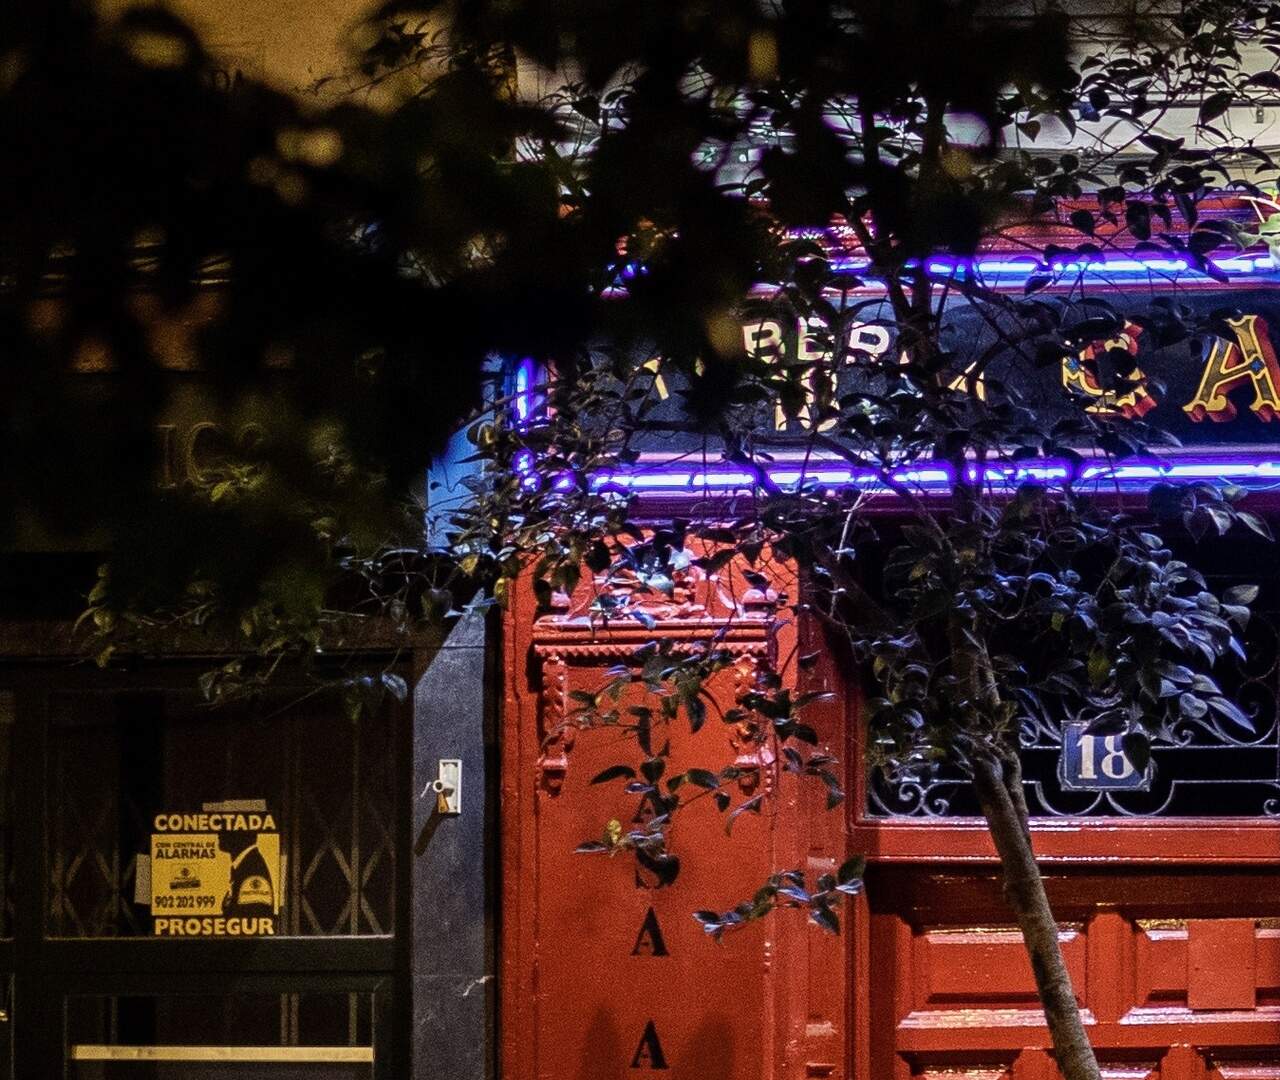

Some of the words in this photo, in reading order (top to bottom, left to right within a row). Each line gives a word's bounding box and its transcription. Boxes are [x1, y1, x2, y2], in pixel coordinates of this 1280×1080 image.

[1077, 734, 1134, 779] 18
[154, 813, 277, 831] CONECTADA
[155, 848, 217, 860] ALARMAS
[155, 894, 174, 908] 902
[175, 894, 195, 908] 202
[154, 917, 275, 936] PROSEGUR
